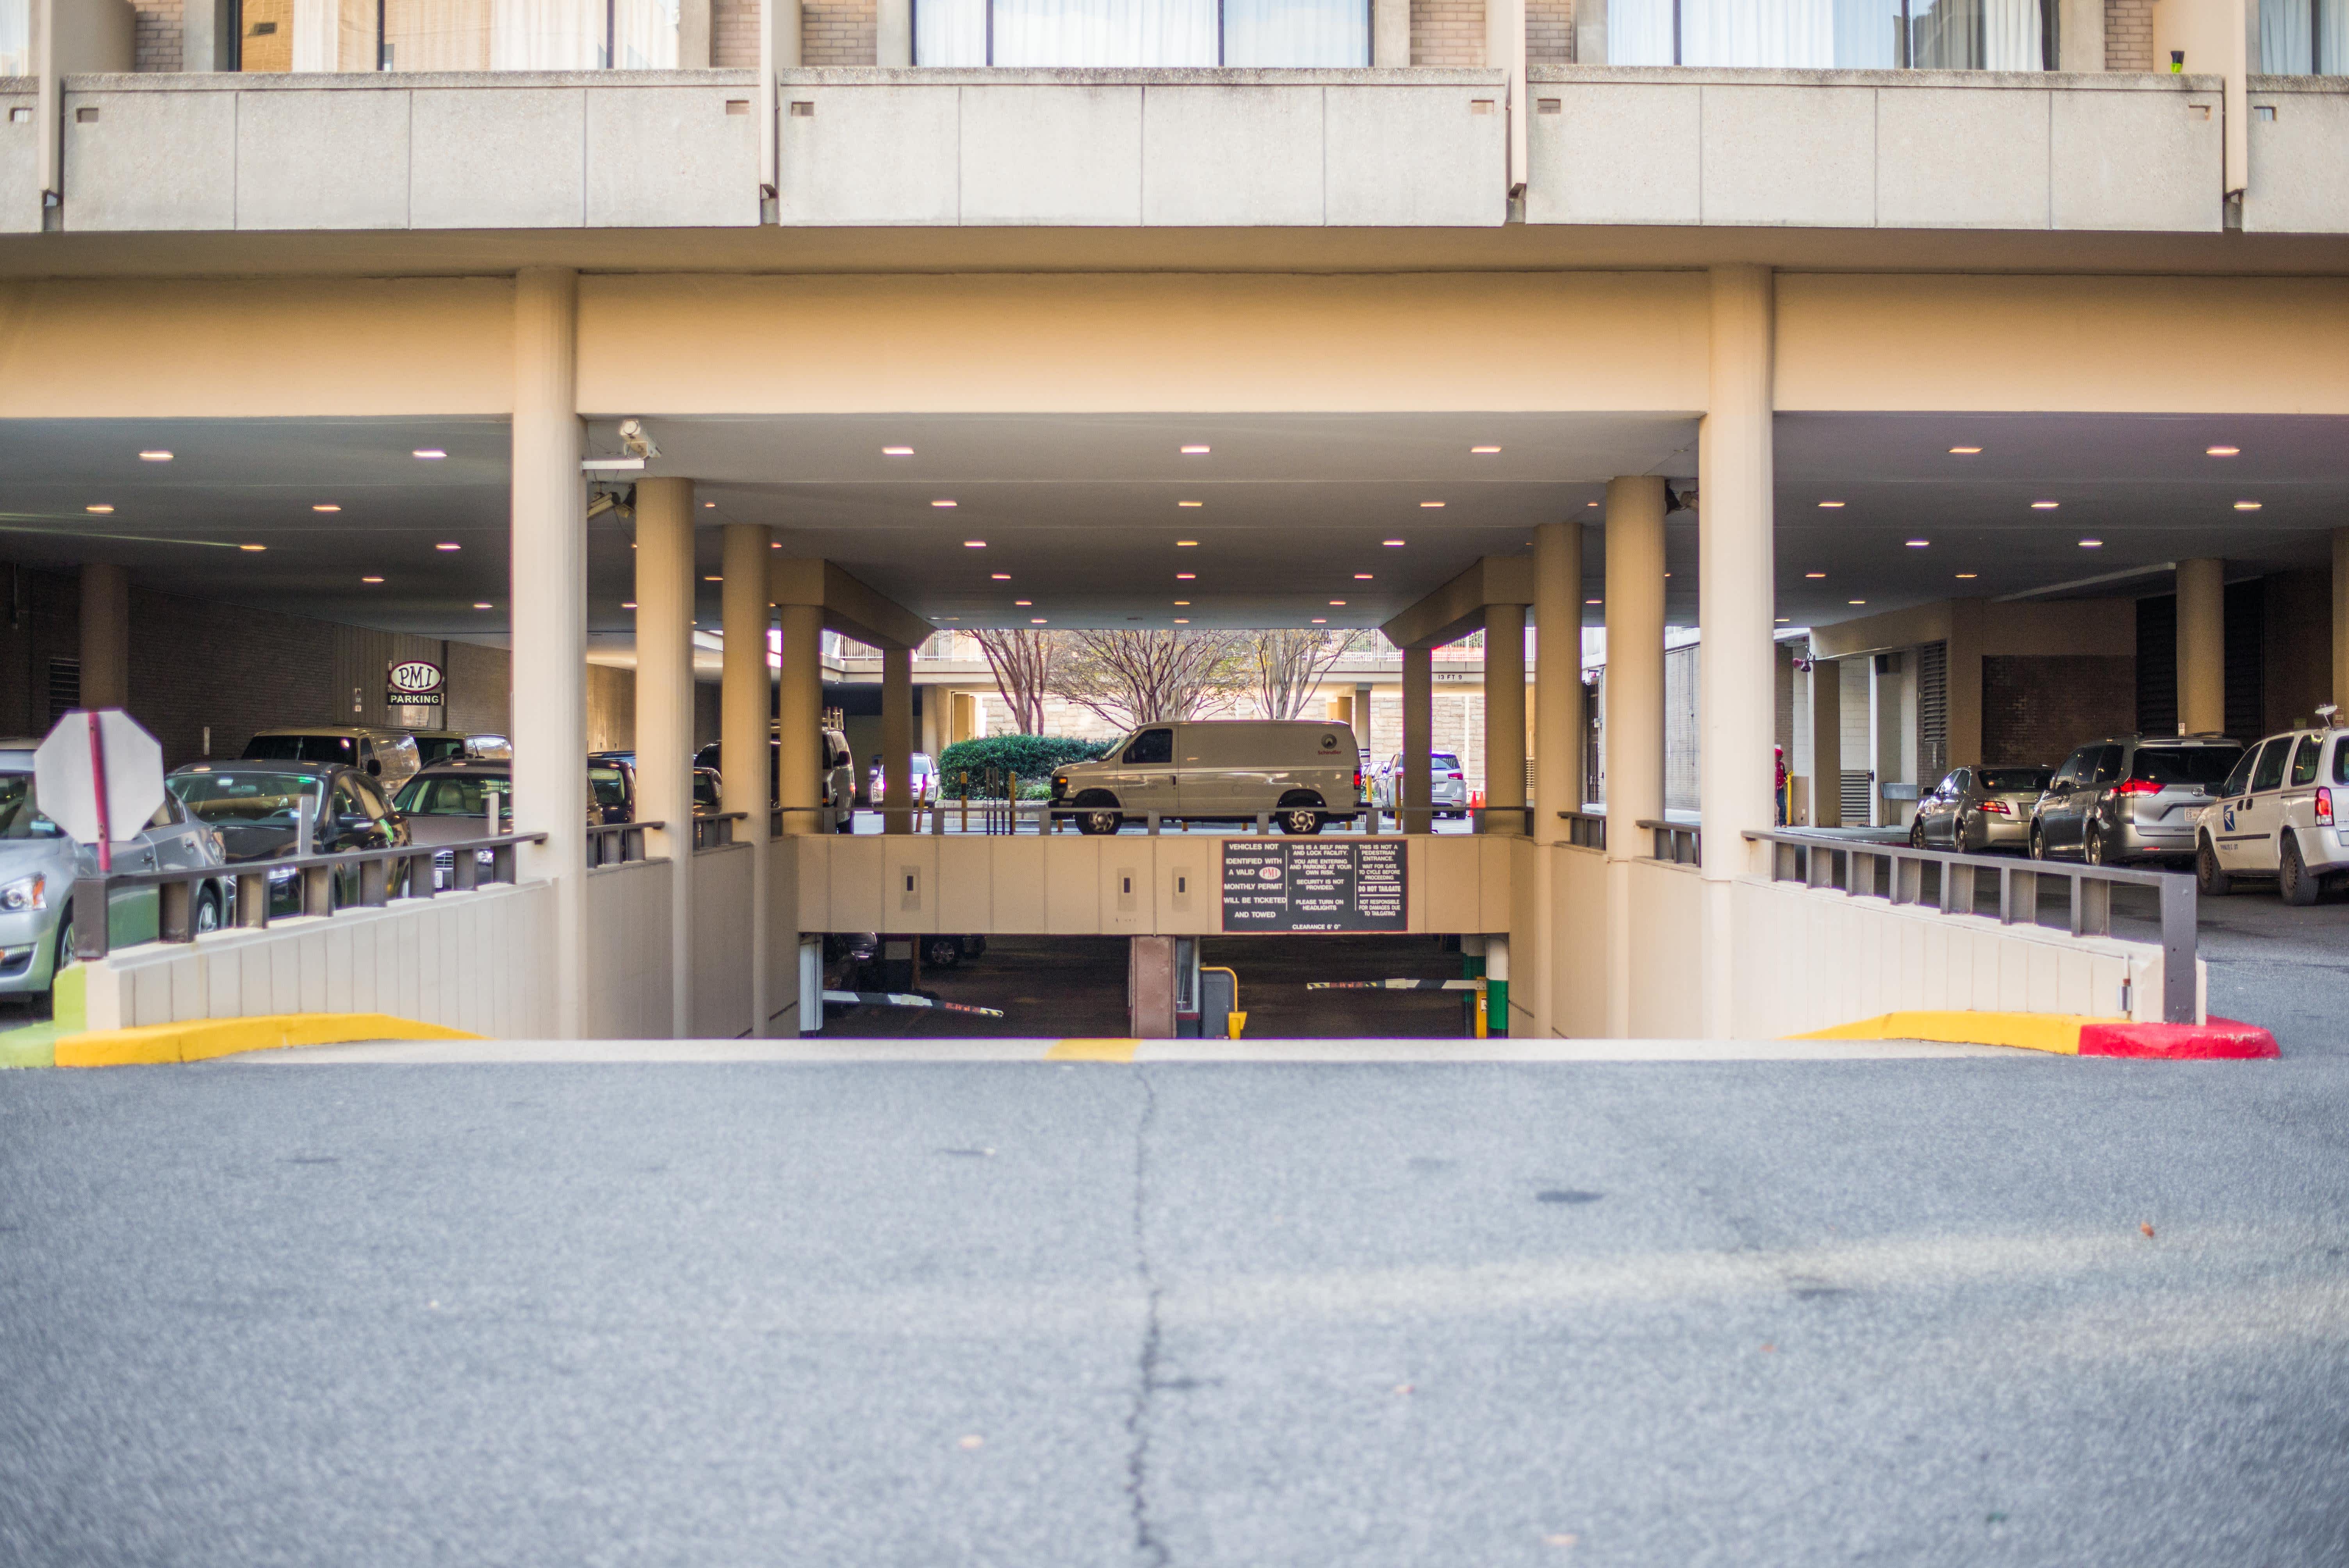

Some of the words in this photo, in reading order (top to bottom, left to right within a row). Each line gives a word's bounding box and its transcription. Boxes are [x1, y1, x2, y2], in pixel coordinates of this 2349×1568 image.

[399, 666, 433, 688] PMI
[390, 695, 439, 703] PARKING
[1262, 868, 1278, 878] PMI
